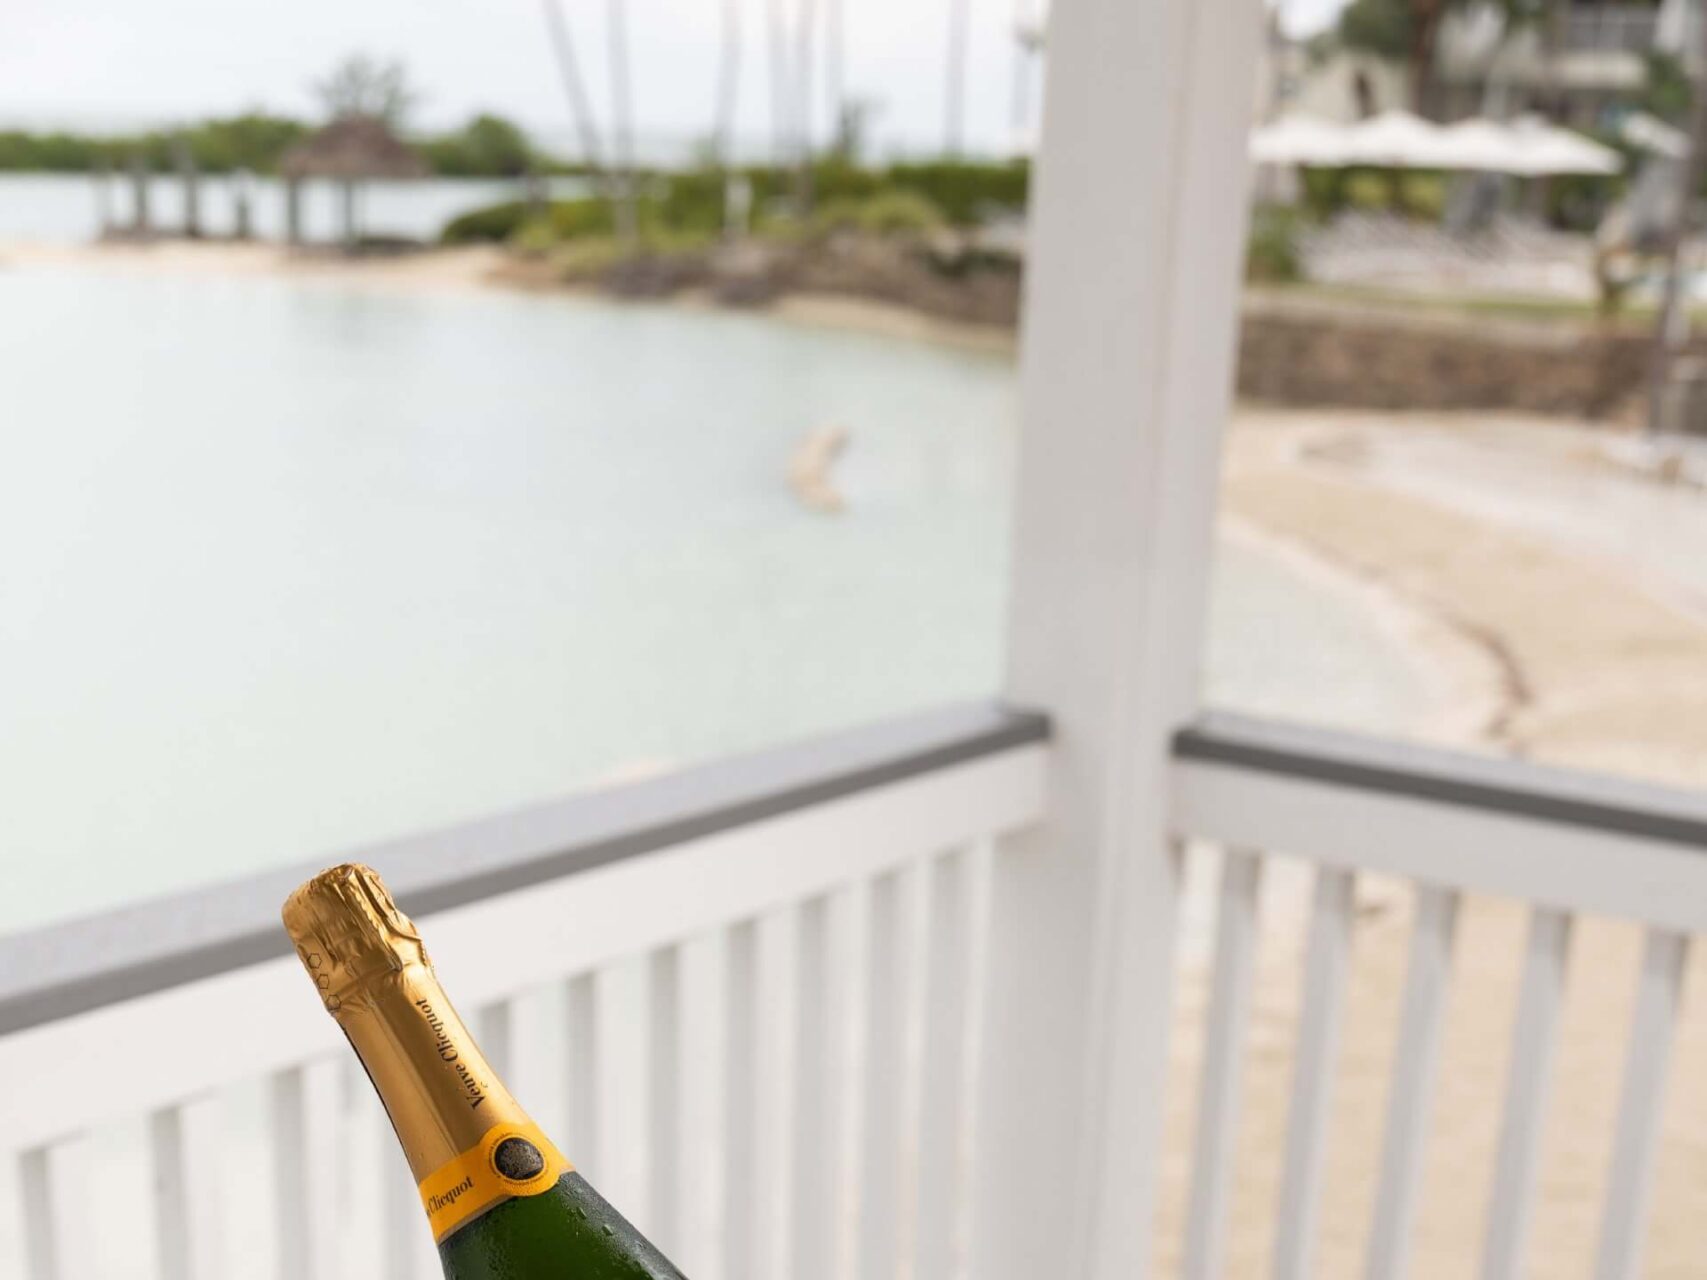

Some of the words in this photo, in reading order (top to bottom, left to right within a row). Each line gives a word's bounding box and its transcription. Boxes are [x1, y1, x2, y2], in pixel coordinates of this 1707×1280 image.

[415, 998, 459, 1062] Clicquot
[455, 1063, 486, 1110] Veuve
[428, 1175, 474, 1214] Clicquot
